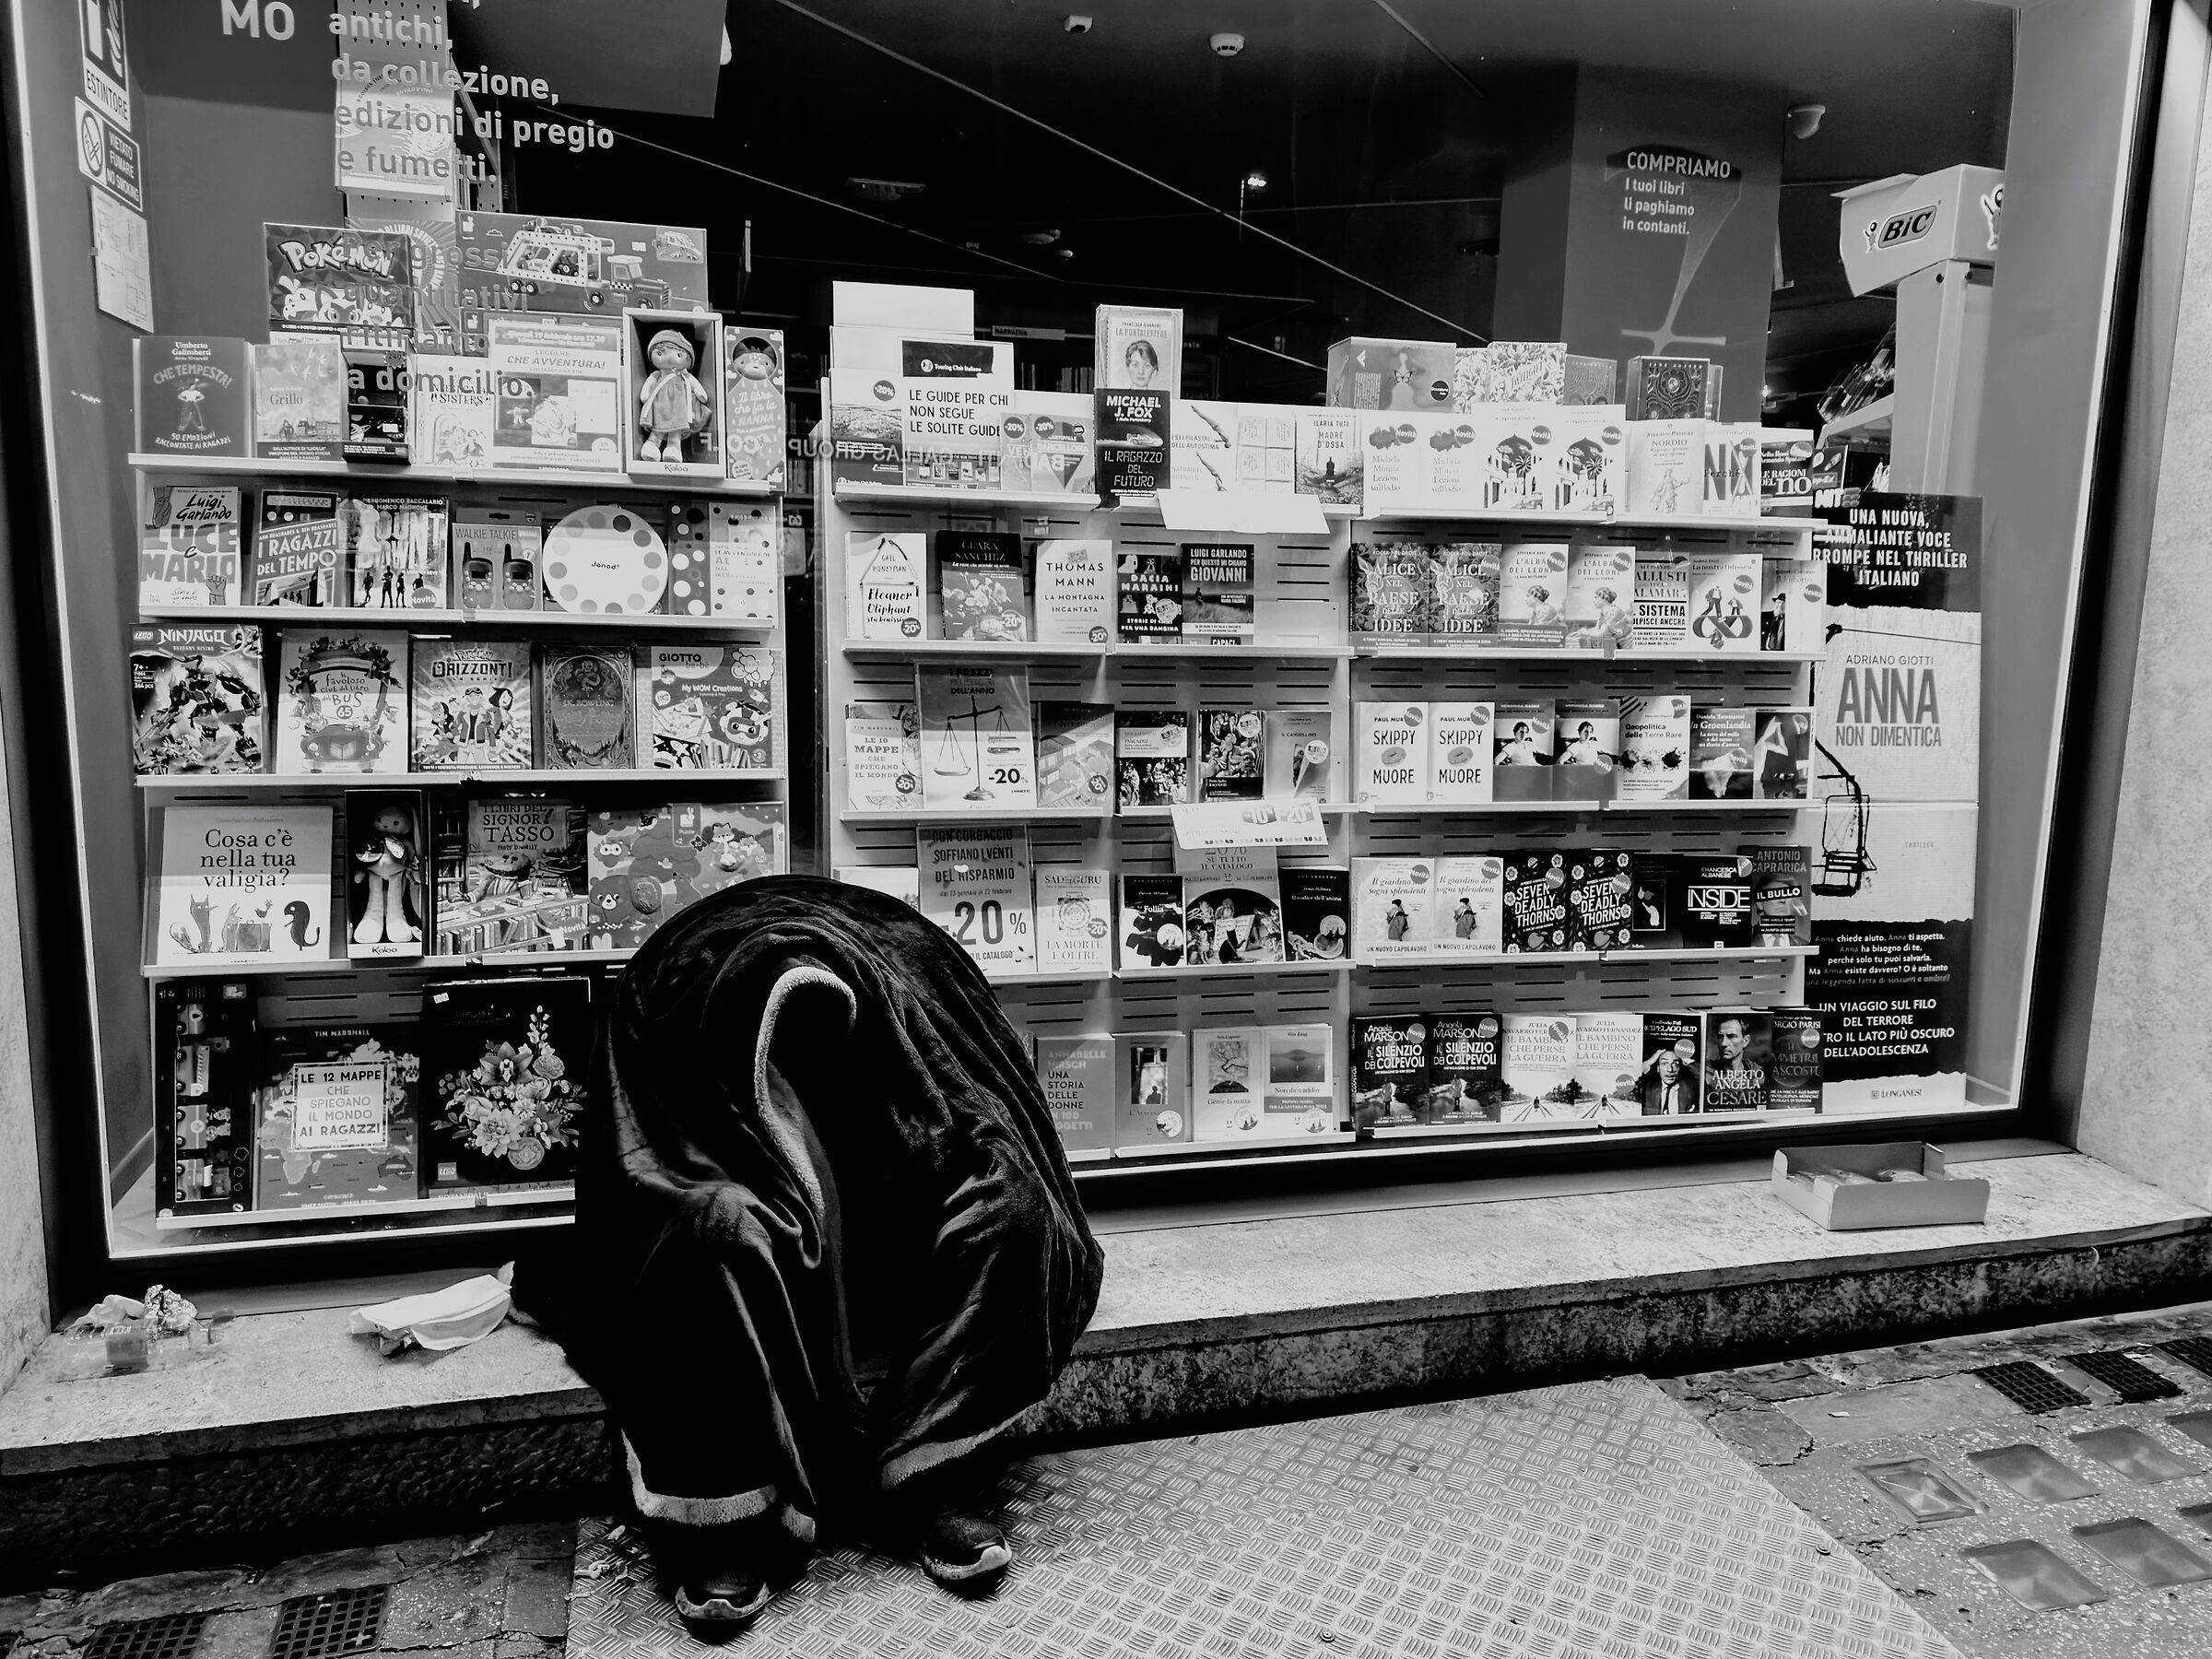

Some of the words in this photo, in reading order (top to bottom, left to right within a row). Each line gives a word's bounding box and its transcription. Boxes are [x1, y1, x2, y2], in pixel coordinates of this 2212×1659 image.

[329, 11, 453, 48] antichi,
[332, 53, 370, 80] da
[382, 60, 559, 105] collezione,
[86, 70, 128, 121] ESTINTORE
[335, 100, 464, 135] edizioni
[474, 111, 501, 138] di
[513, 119, 614, 152] pregio
[337, 150, 354, 170] e
[366, 146, 497, 182] fumetti.
[1627, 151, 1731, 179] COMPRIAMO
[1632, 179, 1656, 193] tuoi
[1659, 181, 1685, 195] libri
[1624, 196, 1632, 210] li
[1635, 200, 1695, 216] paghiamo
[1622, 216, 1634, 230] in
[1637, 220, 1690, 235] contanti.
[507, 356, 529, 365] CHE
[532, 358, 606, 369] AVVENTURA!
[348, 369, 365, 390] a
[376, 366, 533, 396] domicilio.
[269, 394, 303, 406] Grillo
[910, 390, 922, 401] LE
[926, 391, 960, 403] GUIDE
[965, 394, 984, 406] PER
[990, 394, 1008, 406] CHI
[1106, 394, 1161, 408] MICHAEL
[910, 406, 935, 418] NON
[939, 407, 974, 419] SEGUE
[1114, 406, 1124, 418] J.
[1127, 407, 1153, 418] FOX
[911, 421, 922, 432] LE
[927, 422, 964, 435] SOLITE
[970, 424, 1000, 437] GUIDE
[1104, 451, 1114, 462] IL
[1116, 451, 1163, 464] RAGAZZO
[1127, 464, 1143, 474] DEL
[1772, 468, 1806, 478] RAGIONI
[1113, 476, 1154, 488] FUTURO
[186, 494, 224, 508] Luigi
[176, 505, 231, 521] Garlando
[1849, 509, 1877, 524] UNA
[1882, 511, 1929, 529] NUOVA,
[145, 523, 237, 553] LUCE
[455, 528, 488, 540] WALKIE
[489, 529, 517, 540] TALKIE
[1917, 532, 1951, 549] VOCE
[268, 529, 337, 558] RAGAZZI
[1190, 548, 1208, 558] LUIGI
[1211, 549, 1247, 559] GARLANDO
[1813, 549, 1870, 565] RROMPE
[1877, 551, 1901, 567] NEL
[1906, 551, 1968, 569] THRILLER
[143, 553, 235, 583] MARIO
[257, 563, 276, 577] DEL
[278, 548, 337, 575] TEMPO
[1046, 562, 1104, 572] THOMAS
[1373, 563, 1416, 575] ALICE
[1130, 574, 1170, 583] DACIA
[1190, 567, 1246, 582] GIOVANNI
[1859, 570, 1919, 586] ITALIANO
[1055, 578, 1094, 586] MANN
[1121, 582, 1179, 592] MARAINI
[868, 588, 912, 601] Eleanor
[1369, 592, 1418, 606] PAESE
[867, 603, 912, 617] Oliphant
[1639, 605, 1686, 617] SISTEMA
[1373, 618, 1413, 632] IDEE
[157, 629, 230, 645] NINJAGO
[659, 653, 701, 664] GIOTTO
[1846, 655, 1895, 665] ADRIANO
[1899, 656, 1934, 665] GIOTTI
[431, 659, 512, 677] ORIZZONTI
[325, 674, 366, 686] favoloso
[332, 691, 363, 708] BUS
[1836, 667, 1940, 724] ANNA
[1625, 724, 1666, 733] Geopolitica
[1700, 720, 1751, 729] Groenlandia
[1373, 730, 1416, 745] SKIPPY
[1440, 730, 1482, 745] SKIPPY
[1836, 725, 1864, 747] NON
[1871, 725, 1941, 747] DIMENTICA
[854, 746, 899, 754] MAPPE
[1373, 769, 1415, 783] MUORE
[1439, 769, 1481, 783] MUORE
[483, 814, 542, 826] SIGNOR
[205, 829, 258, 848] Cosa
[265, 829, 293, 847] c'è
[486, 826, 555, 842] TASSO
[932, 830, 953, 842] CON
[957, 828, 1013, 842] CORBACCIO
[200, 849, 254, 868] nella
[263, 852, 296, 866] tua
[1757, 851, 1801, 861] ANTONIO
[1752, 862, 1806, 873] CAPRARICA
[203, 867, 289, 893] valigia?
[935, 869, 954, 883] DEL
[959, 867, 1015, 882] RISPARMIO
[1516, 882, 1550, 900] SEVEN
[1757, 891, 1765, 900] IL
[1768, 888, 1800, 899] BULLO
[1515, 895, 1556, 914] DEADLY
[1688, 888, 1751, 909] INSIDE
[1516, 909, 1556, 927] THORNS
[1828, 956, 1853, 965] perché
[1884, 955, 1901, 965] puoi
[1903, 954, 1932, 962] salvarla.
[1819, 1002, 1837, 1012] UN
[1840, 1001, 1888, 1012] VIAGGIO
[1891, 1000, 1911, 1011] SUL
[1913, 999, 1936, 1009] FILO
[1843, 1017, 1863, 1027] DEL
[1866, 1015, 1913, 1026] TERRORE
[1845, 1032, 1855, 1042] IL
[1858, 1031, 1887, 1041] LATO
[1889, 1028, 1908, 1040] PIÙ
[1911, 1028, 1955, 1040] OSCURO
[1376, 1045, 1422, 1057] SILENZIO
[1445, 1042, 1494, 1053] SILENZIO
[1824, 1045, 1928, 1057] DELL'ADOLESCENZA
[1377, 1056, 1425, 1069] COLPEVOLI
[1446, 1053, 1496, 1065] COLPEVOLI
[300, 1071, 317, 1083] LE
[323, 1072, 335, 1082] 12
[340, 1070, 382, 1082] MAPPE
[1048, 1071, 1069, 1079] UNA
[1712, 1070, 1764, 1081] ALBERTO
[326, 1085, 350, 1096] CHE
[1048, 1081, 1085, 1089] STORIA
[1715, 1079, 1760, 1089] ANGELA
[1048, 1091, 1077, 1100] DELLE
[1707, 1091, 1767, 1105] CESARE
[1881, 1089, 1922, 1100] LONGANESI
[310, 1096, 371, 1109] SPIEGANO
[1048, 1101, 1083, 1110] DONNE
[309, 1111, 317, 1120] IL
[319, 1109, 372, 1120] MONDO
[300, 1125, 314, 1136] AI
[321, 1123, 380, 1135] RAGAZZI
